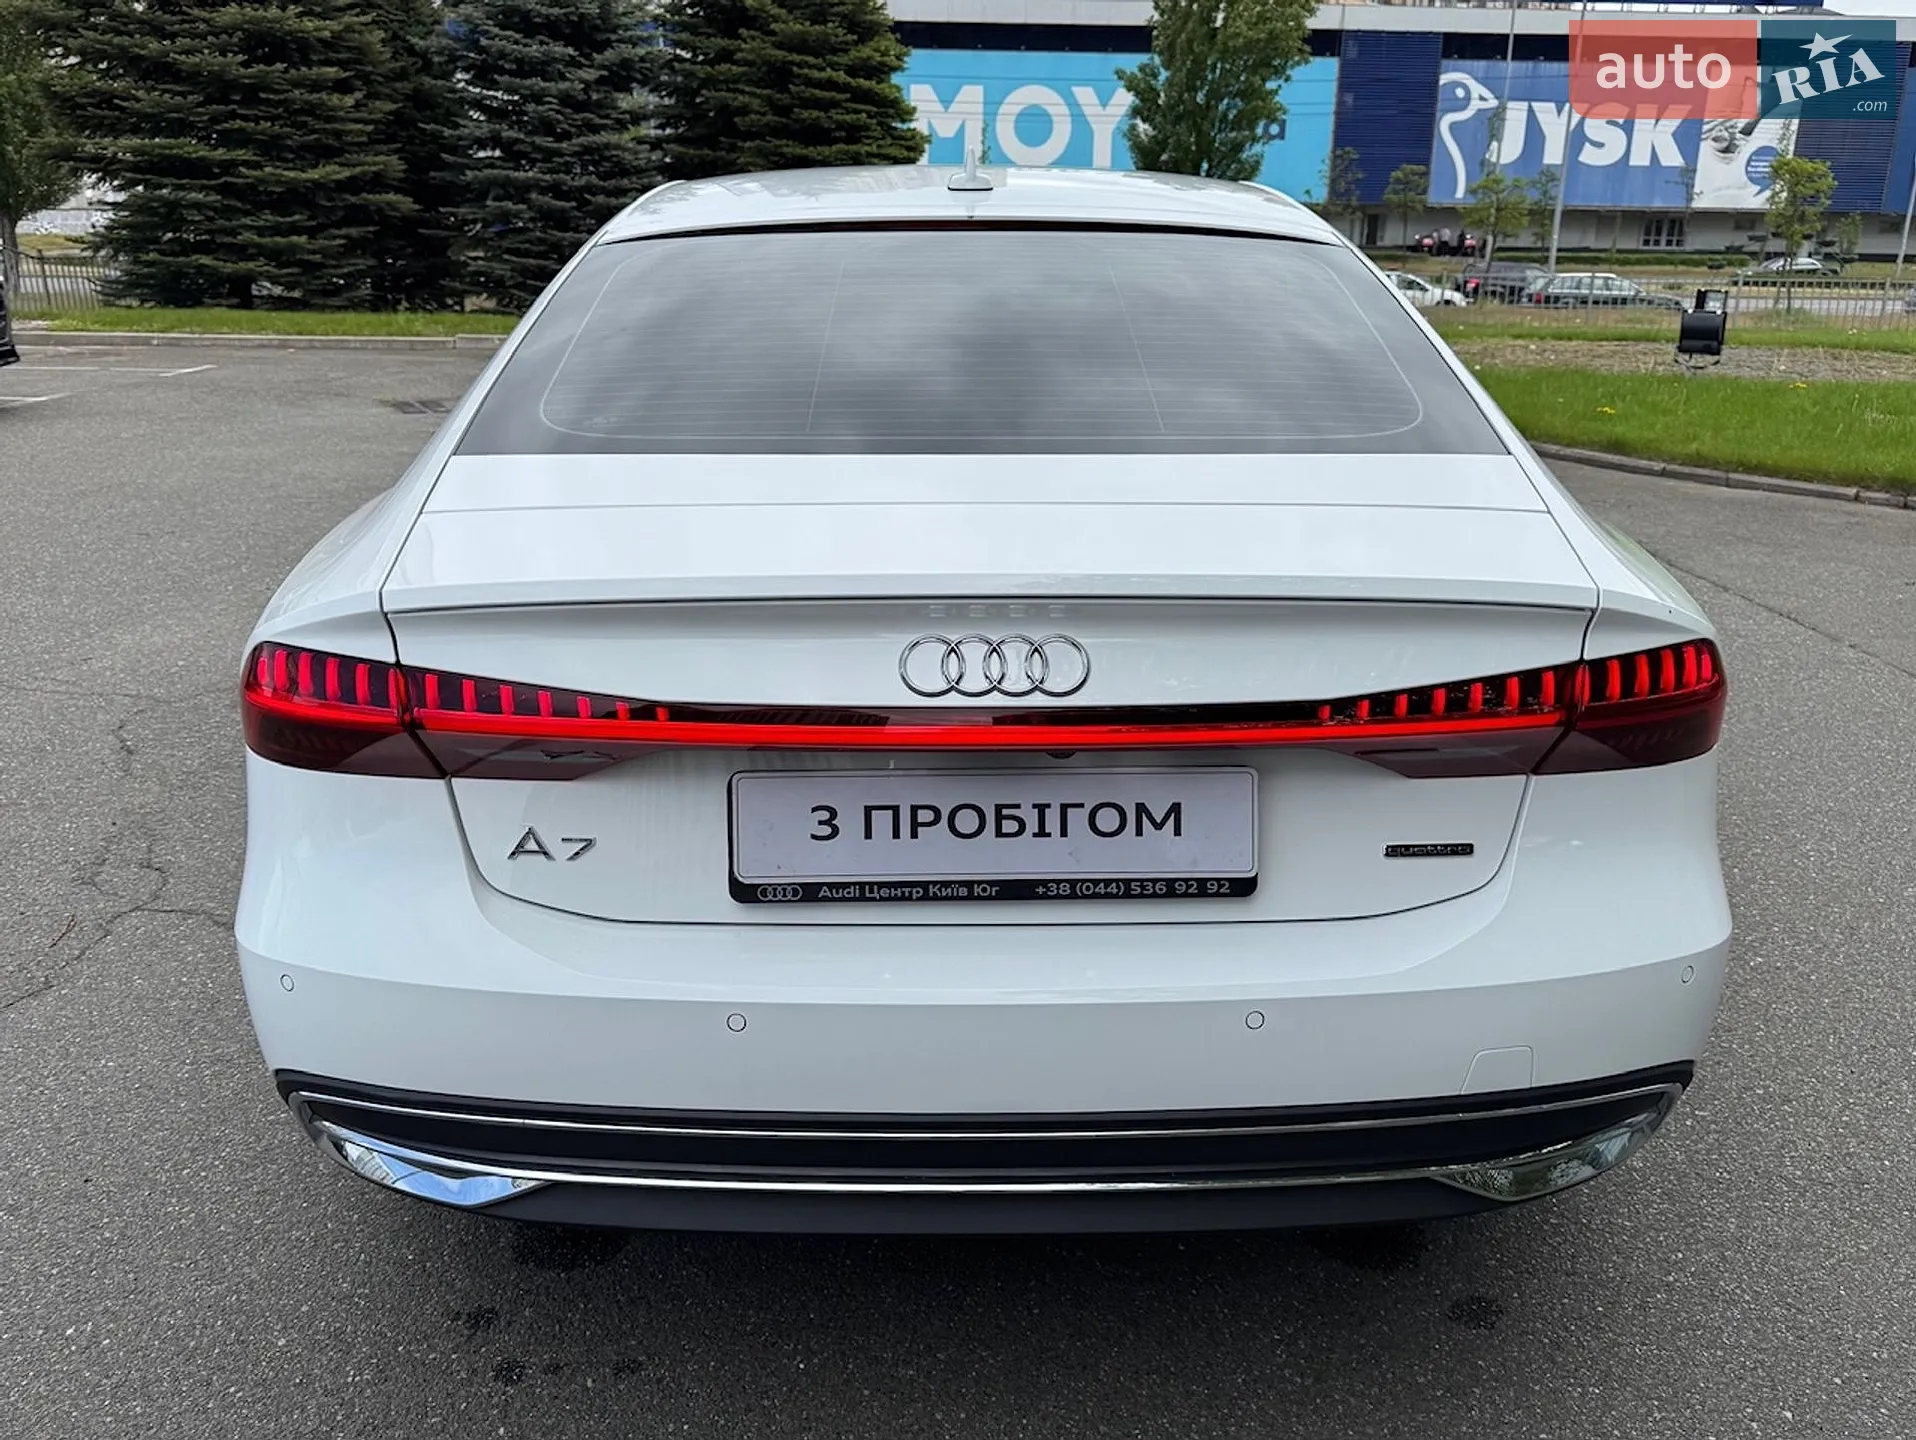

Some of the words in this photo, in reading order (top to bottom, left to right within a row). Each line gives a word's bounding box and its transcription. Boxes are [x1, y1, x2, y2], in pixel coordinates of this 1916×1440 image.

[909, 84, 1155, 167] MOY
[1486, 101, 1692, 167] JYSK
[863, 801, 1183, 840] ПРОБІГОМ
[507, 826, 597, 861] A7
[818, 885, 860, 898] Audi
[865, 885, 924, 900] Центр
[928, 884, 968, 897] Київ
[973, 884, 1000, 897] Юг
[1035, 882, 1072, 895] +38
[1075, 881, 1125, 897] (044)
[1130, 881, 1168, 895] 536
[1174, 880, 1199, 894] 92
[1206, 880, 1231, 894] 92
